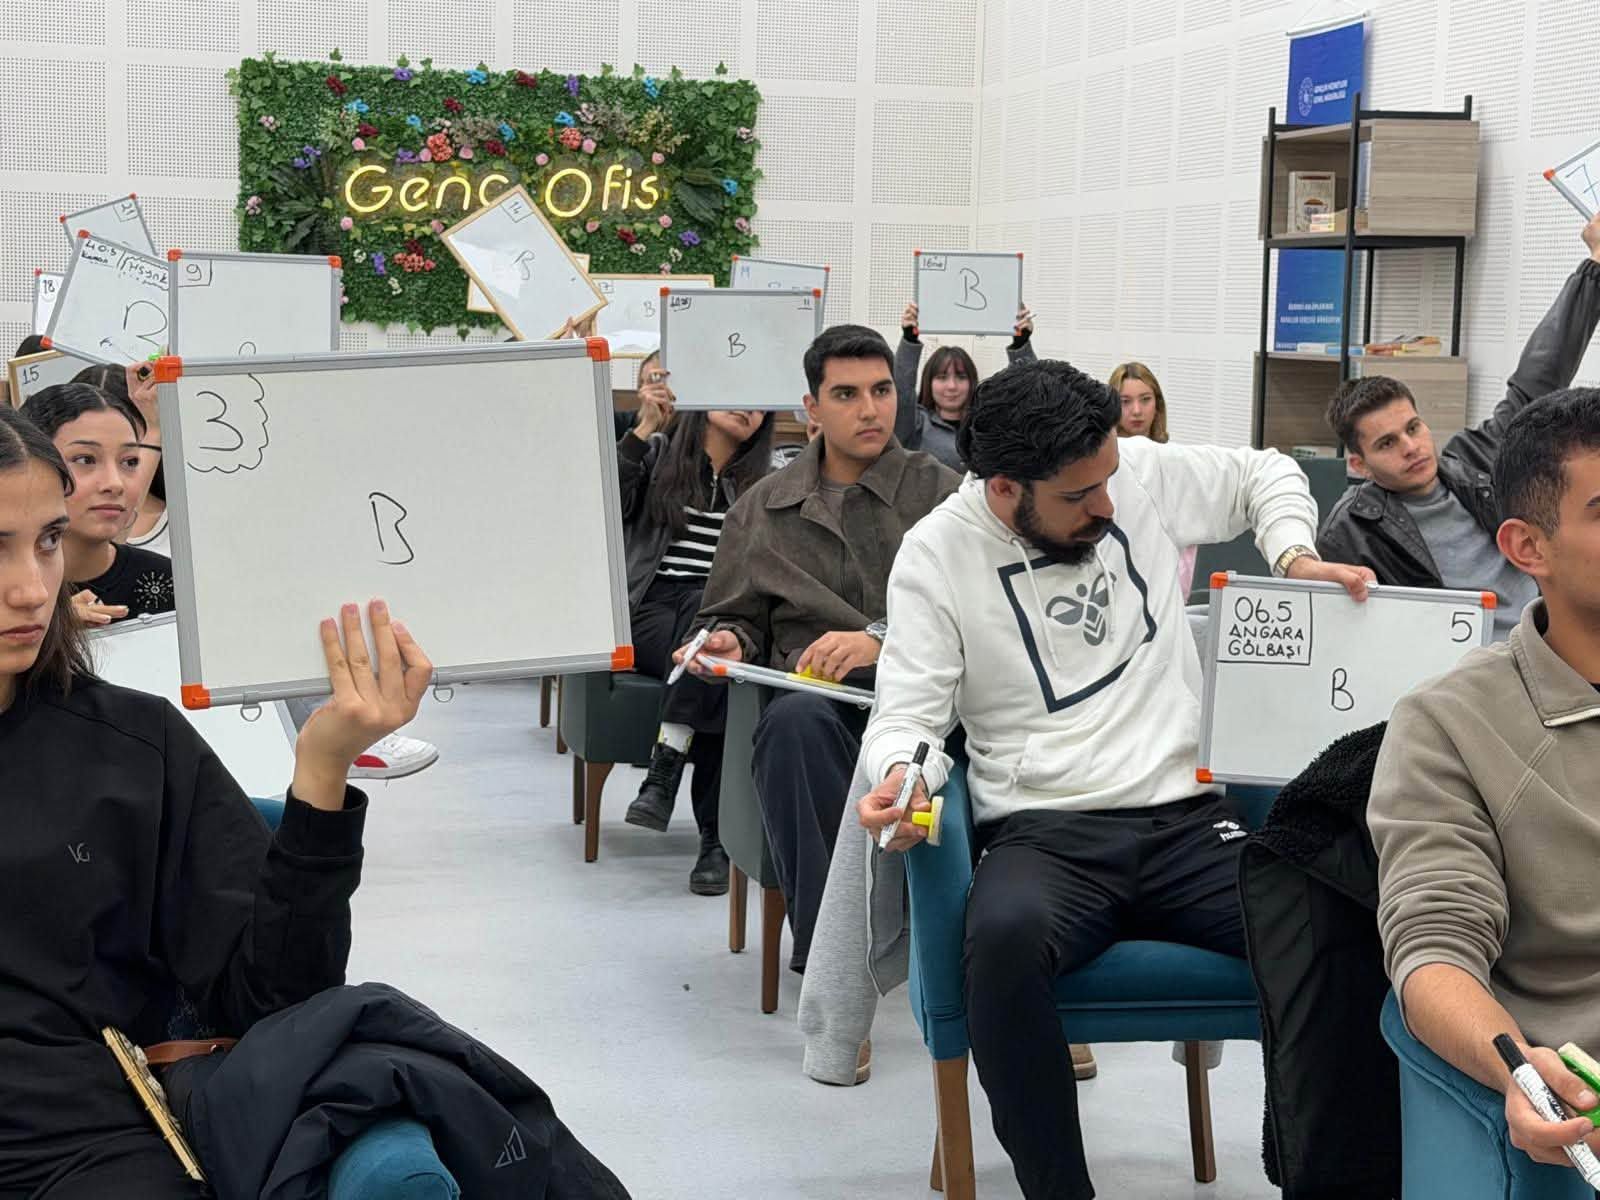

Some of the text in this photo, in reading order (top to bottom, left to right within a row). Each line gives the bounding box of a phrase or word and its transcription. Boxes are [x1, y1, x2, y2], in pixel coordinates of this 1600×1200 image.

[544, 164, 660, 219] Ofis
[43, 279, 56, 294] 18
[186, 263, 203, 282] 9
[953, 266, 988, 311] B
[727, 331, 747, 358] B
[22, 364, 41, 385] 15
[196, 390, 244, 452] 3
[368, 491, 415, 566] B
[1234, 595, 1293, 624] 06.5
[1229, 623, 1305, 641] ANGARA
[1450, 611, 1477, 643] 5
[1330, 667, 1355, 712] B
